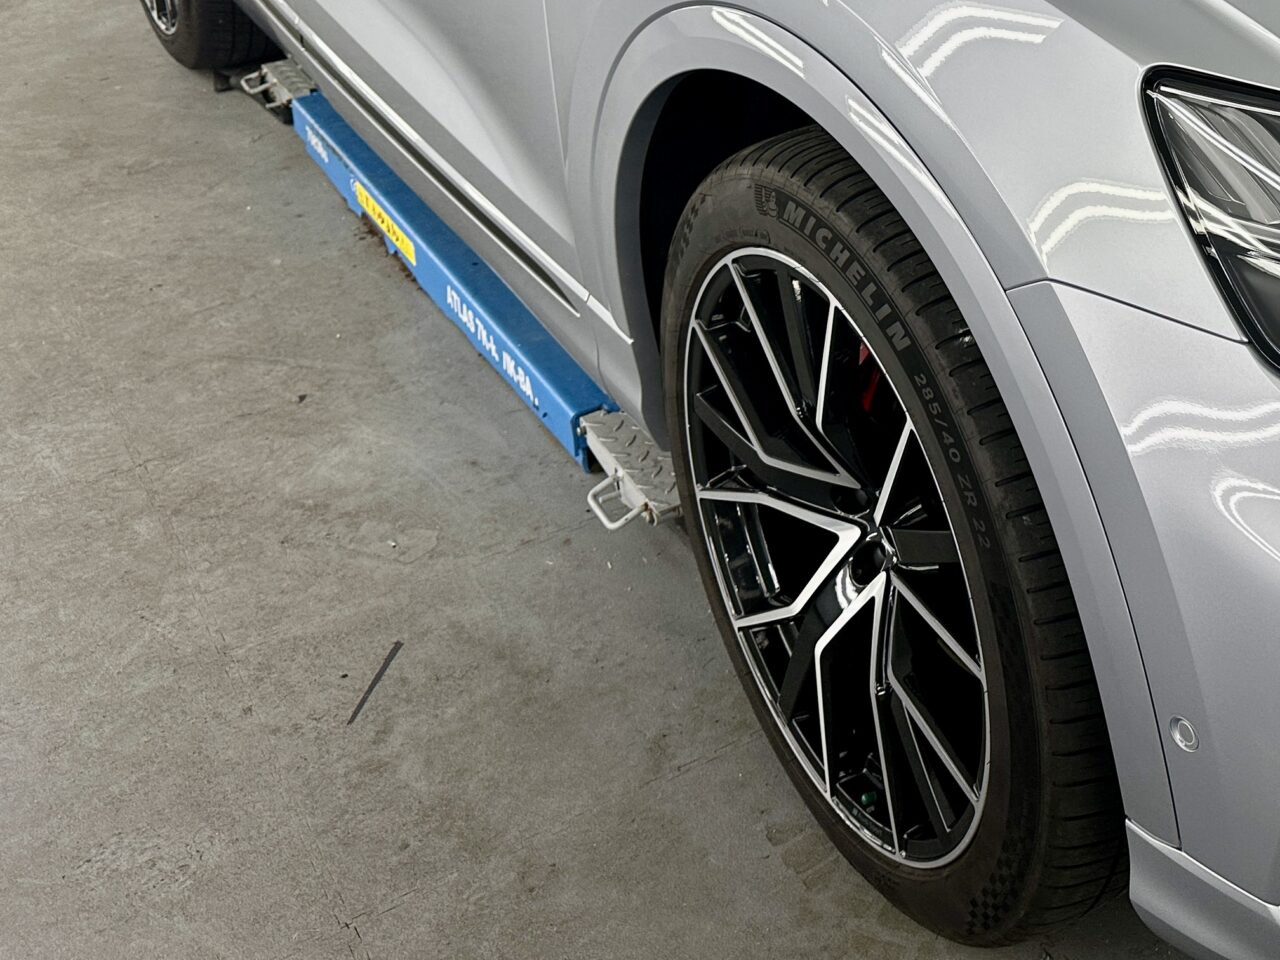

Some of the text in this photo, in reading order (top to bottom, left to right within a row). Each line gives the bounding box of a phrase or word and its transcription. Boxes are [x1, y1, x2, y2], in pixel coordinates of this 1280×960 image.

[783, 200, 912, 352] MICHELIN
[914, 373, 990, 549] 285/40 ZR 22
